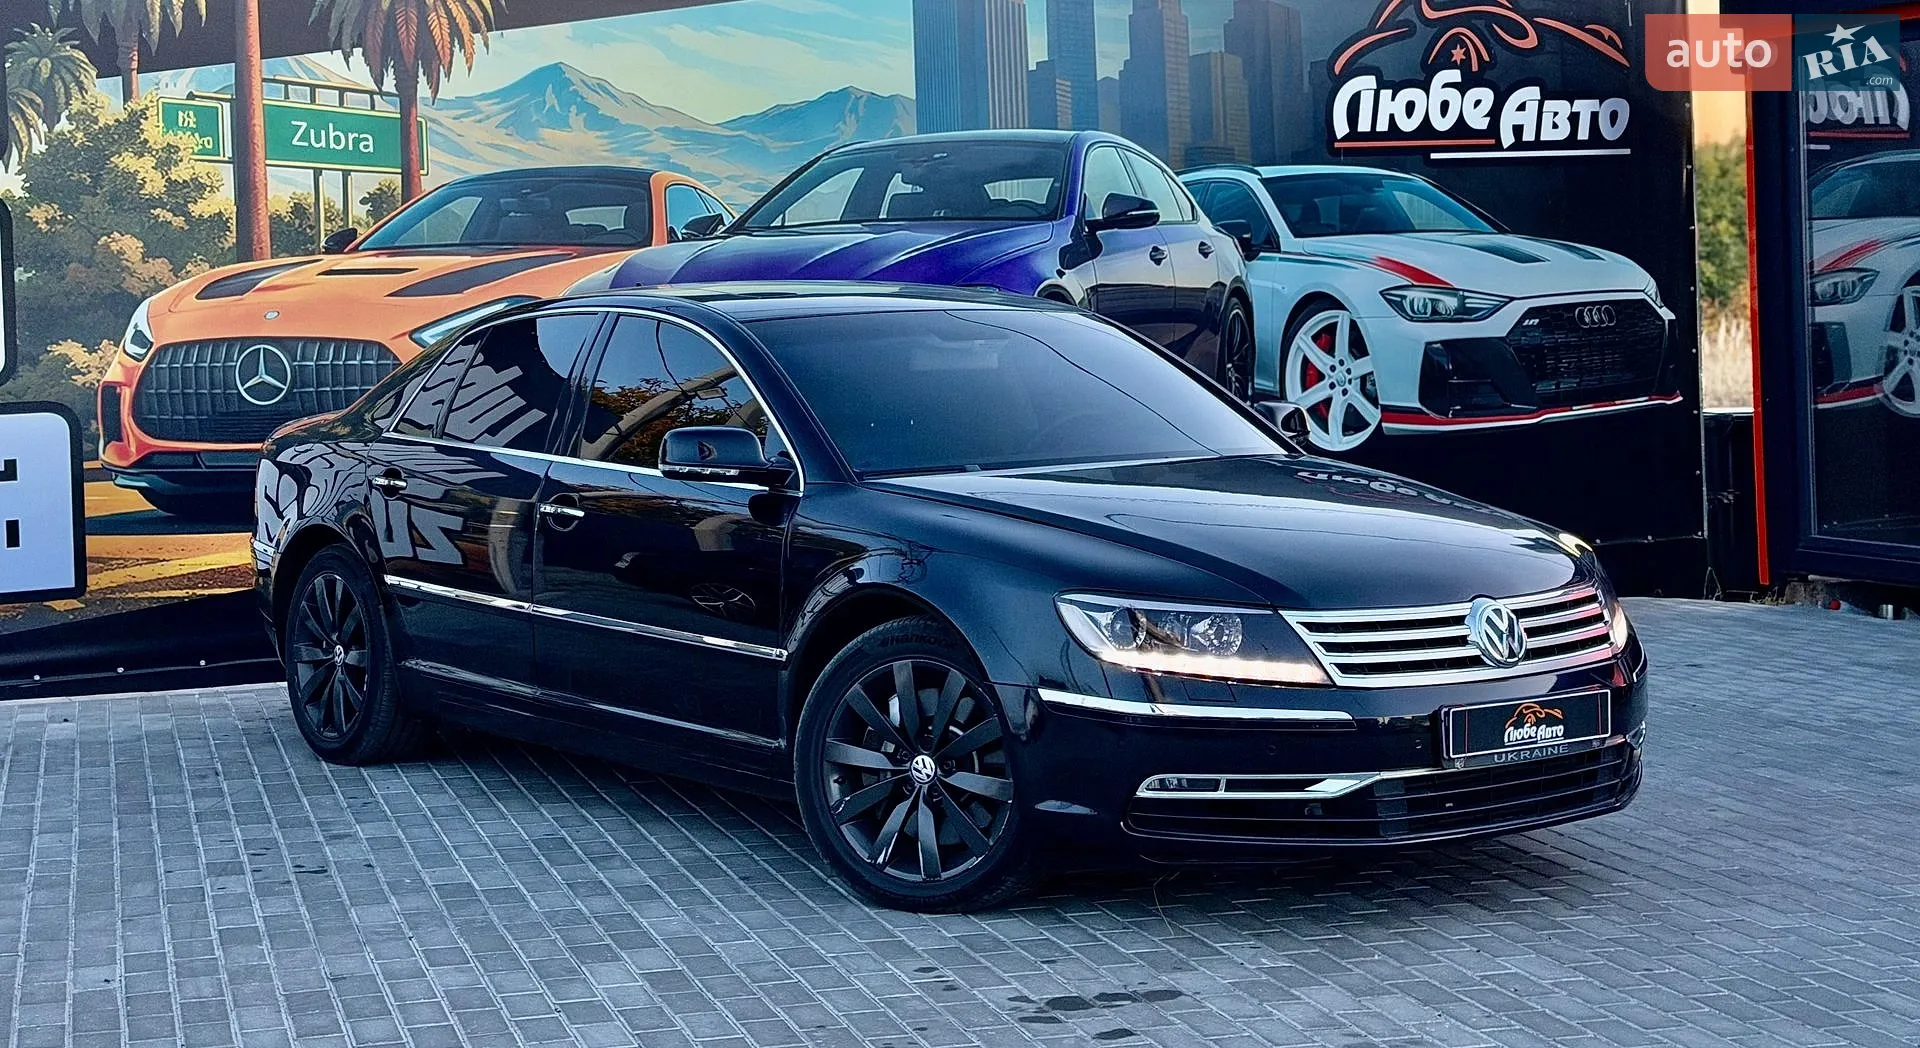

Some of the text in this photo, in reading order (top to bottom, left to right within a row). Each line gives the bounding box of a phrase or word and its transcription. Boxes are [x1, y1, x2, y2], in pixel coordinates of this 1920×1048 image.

[1332, 69, 1630, 150] Любе Авто
[290, 120, 375, 153] Zubra
[1504, 723, 1565, 743] Любе Авто
[1494, 744, 1569, 763] UKRAINE
